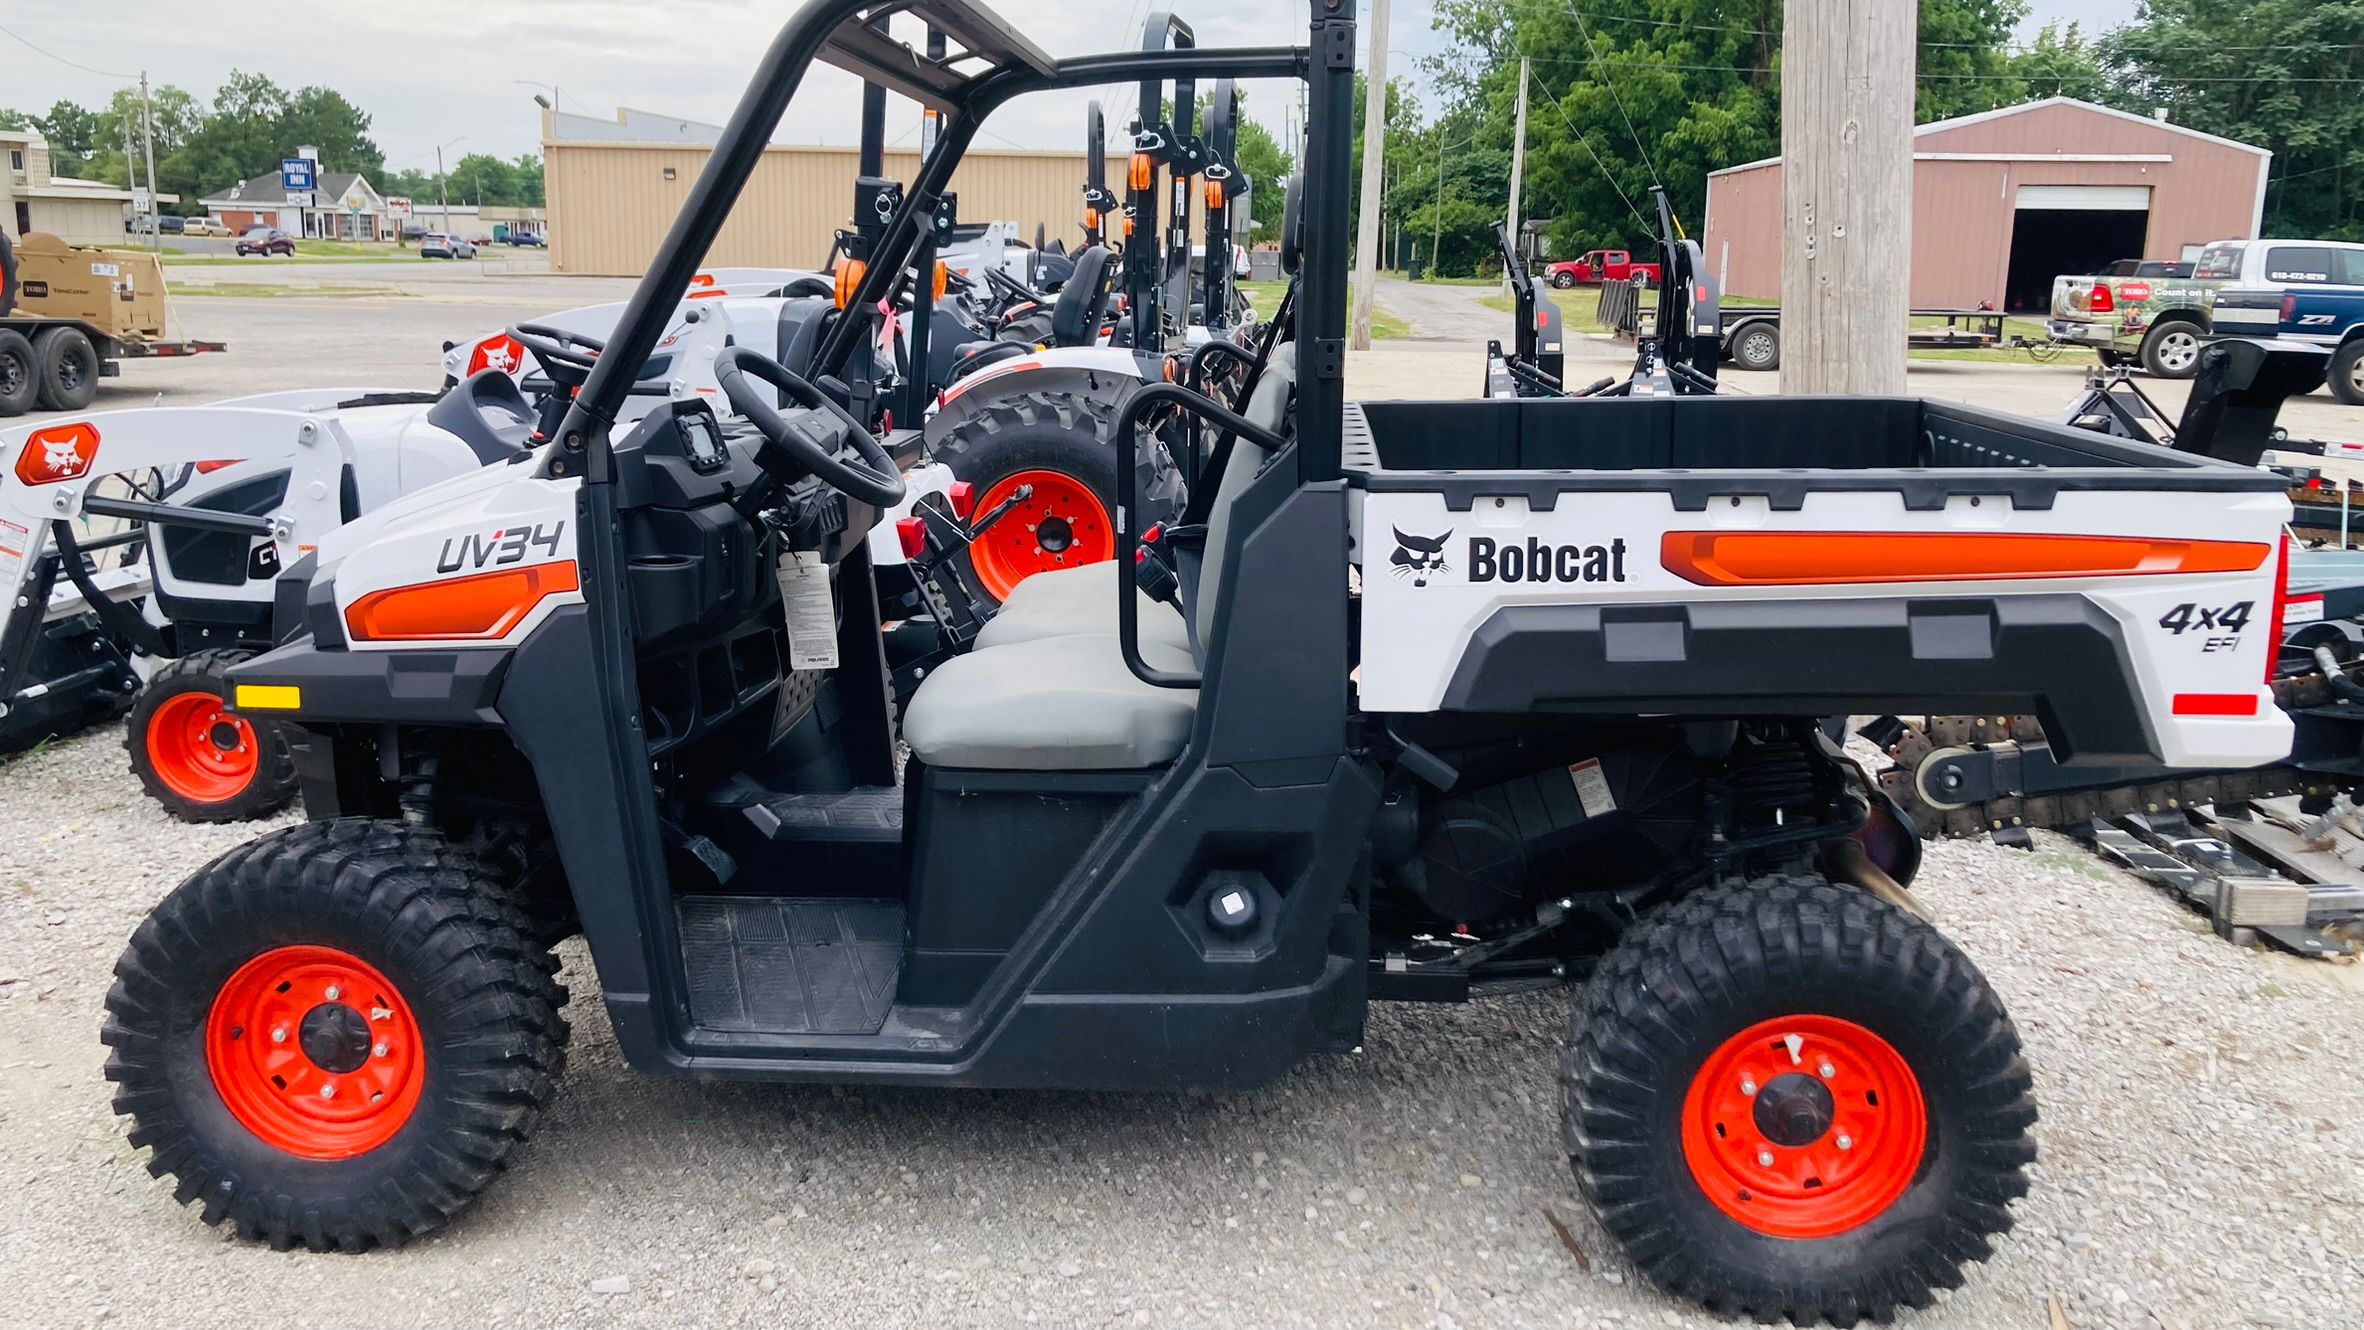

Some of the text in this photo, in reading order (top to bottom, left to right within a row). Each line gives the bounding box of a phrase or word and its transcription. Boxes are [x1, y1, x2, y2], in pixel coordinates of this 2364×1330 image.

[284, 162, 309, 174] ROYAL
[289, 174, 306, 185] INN
[136, 201, 147, 209] 37
[24, 285, 47, 293] TORO
[2124, 287, 2217, 297] TORO Count on it.
[437, 521, 565, 573] UV34
[1467, 536, 1626, 583] Bobcat
[2159, 602, 2255, 634] 4x4
[2202, 637, 2241, 652] EFI
